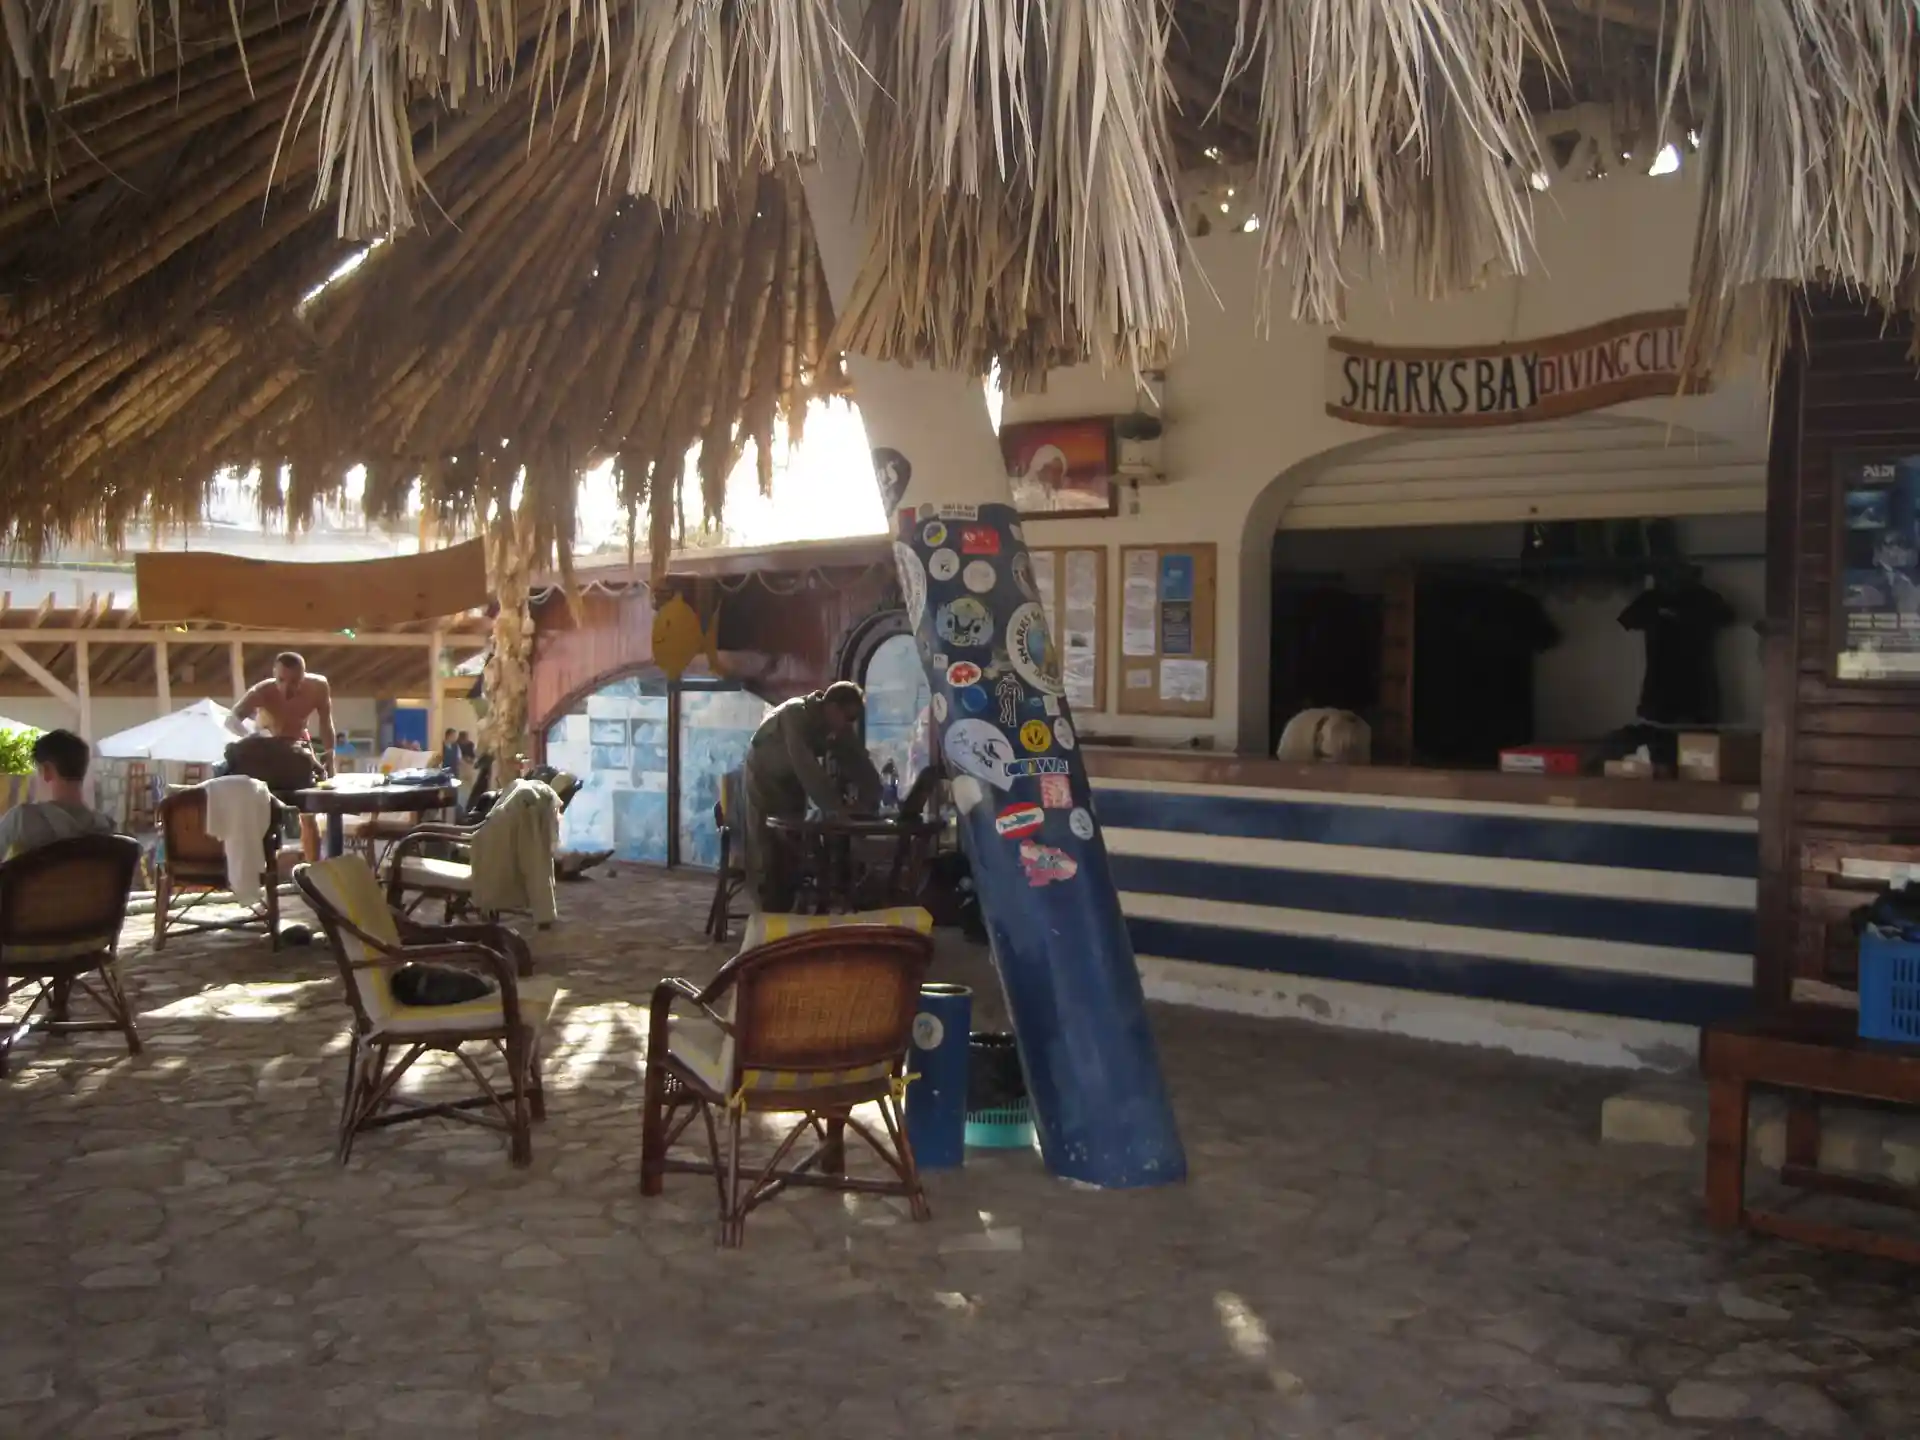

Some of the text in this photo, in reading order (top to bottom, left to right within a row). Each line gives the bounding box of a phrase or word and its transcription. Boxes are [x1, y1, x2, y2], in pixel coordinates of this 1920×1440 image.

[1341, 326, 1701, 415] SHARKS BAY DIVING CLU
